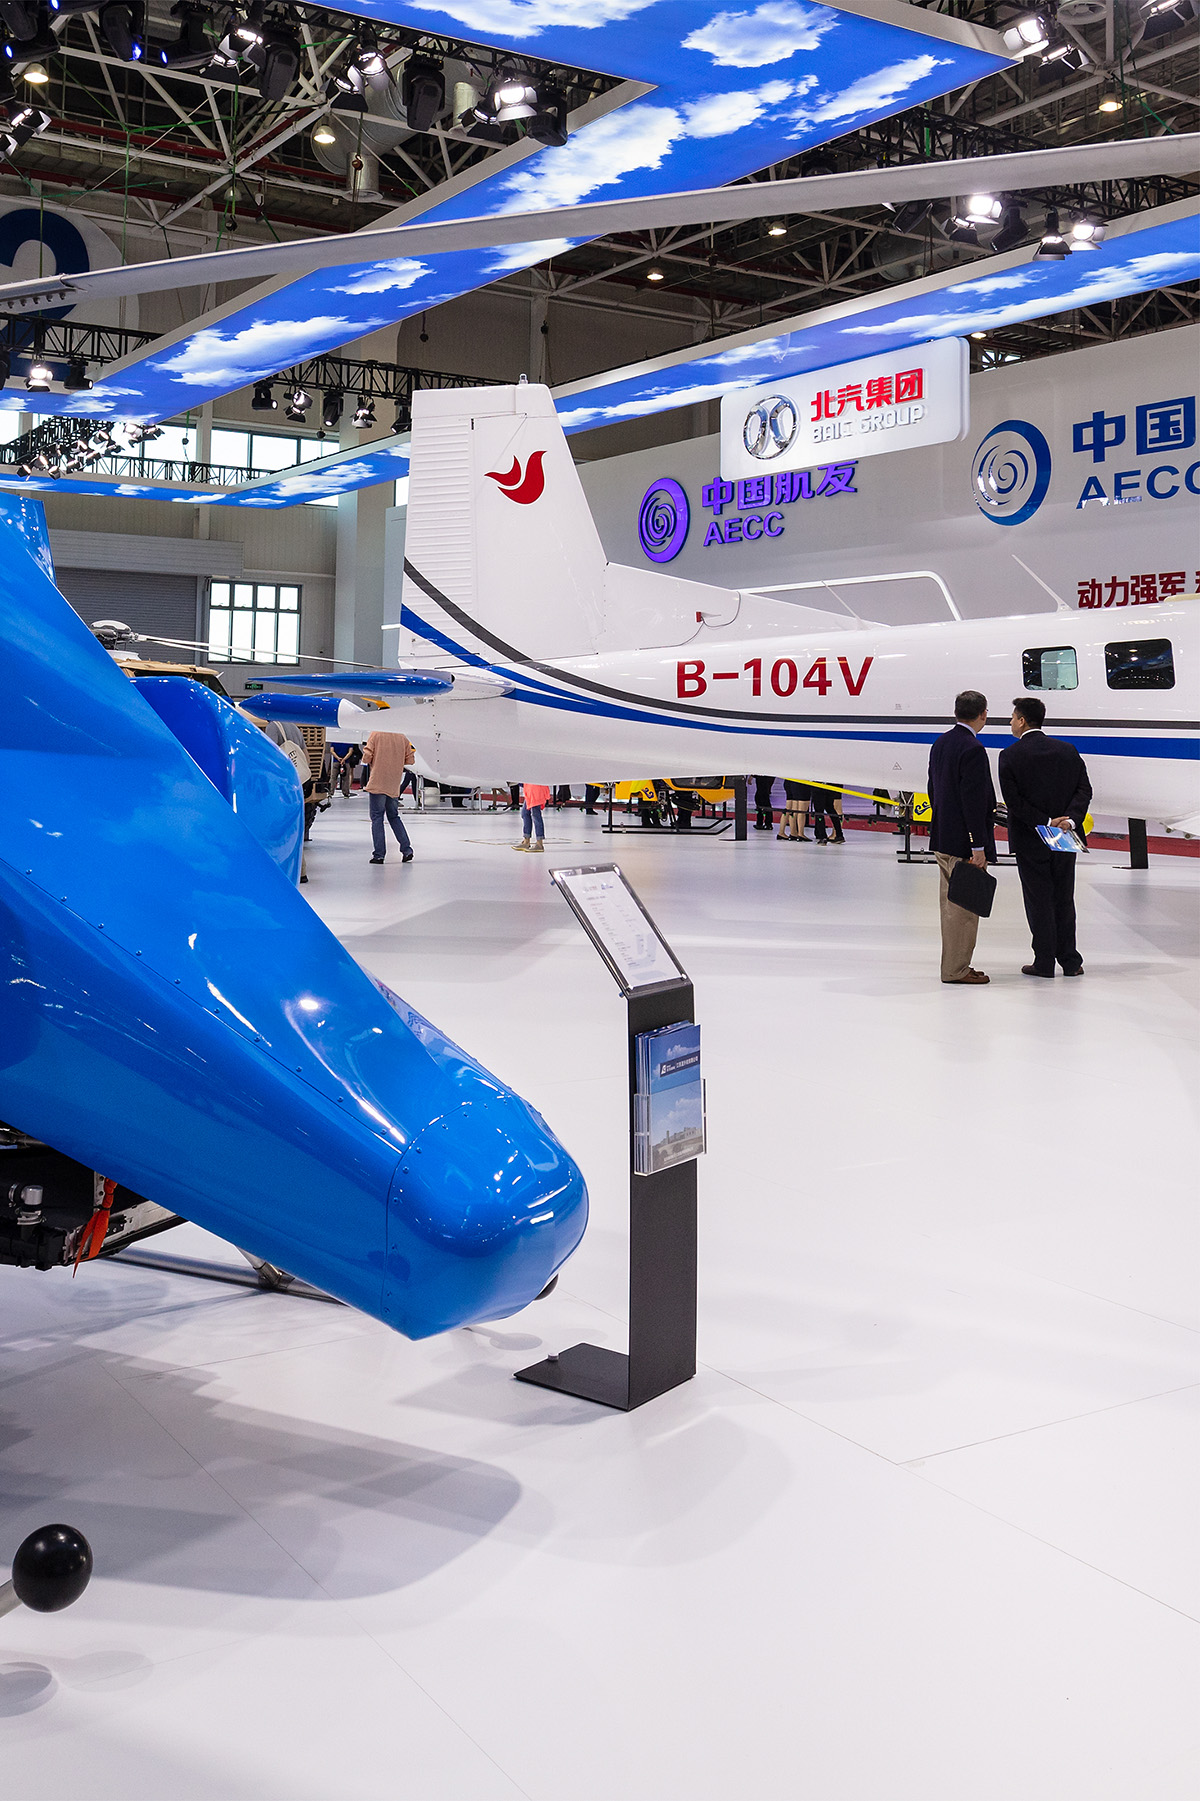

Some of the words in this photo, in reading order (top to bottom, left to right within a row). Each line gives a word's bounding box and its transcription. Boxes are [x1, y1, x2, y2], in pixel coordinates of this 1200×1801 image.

[810, 367, 924, 423] 北汽集团
[860, 404, 925, 434] GROUP
[1072, 395, 1197, 463] 中国
[702, 511, 784, 547] AECC
[1077, 571, 1186, 610] 动力强军
[676, 656, 874, 699] B-104V
